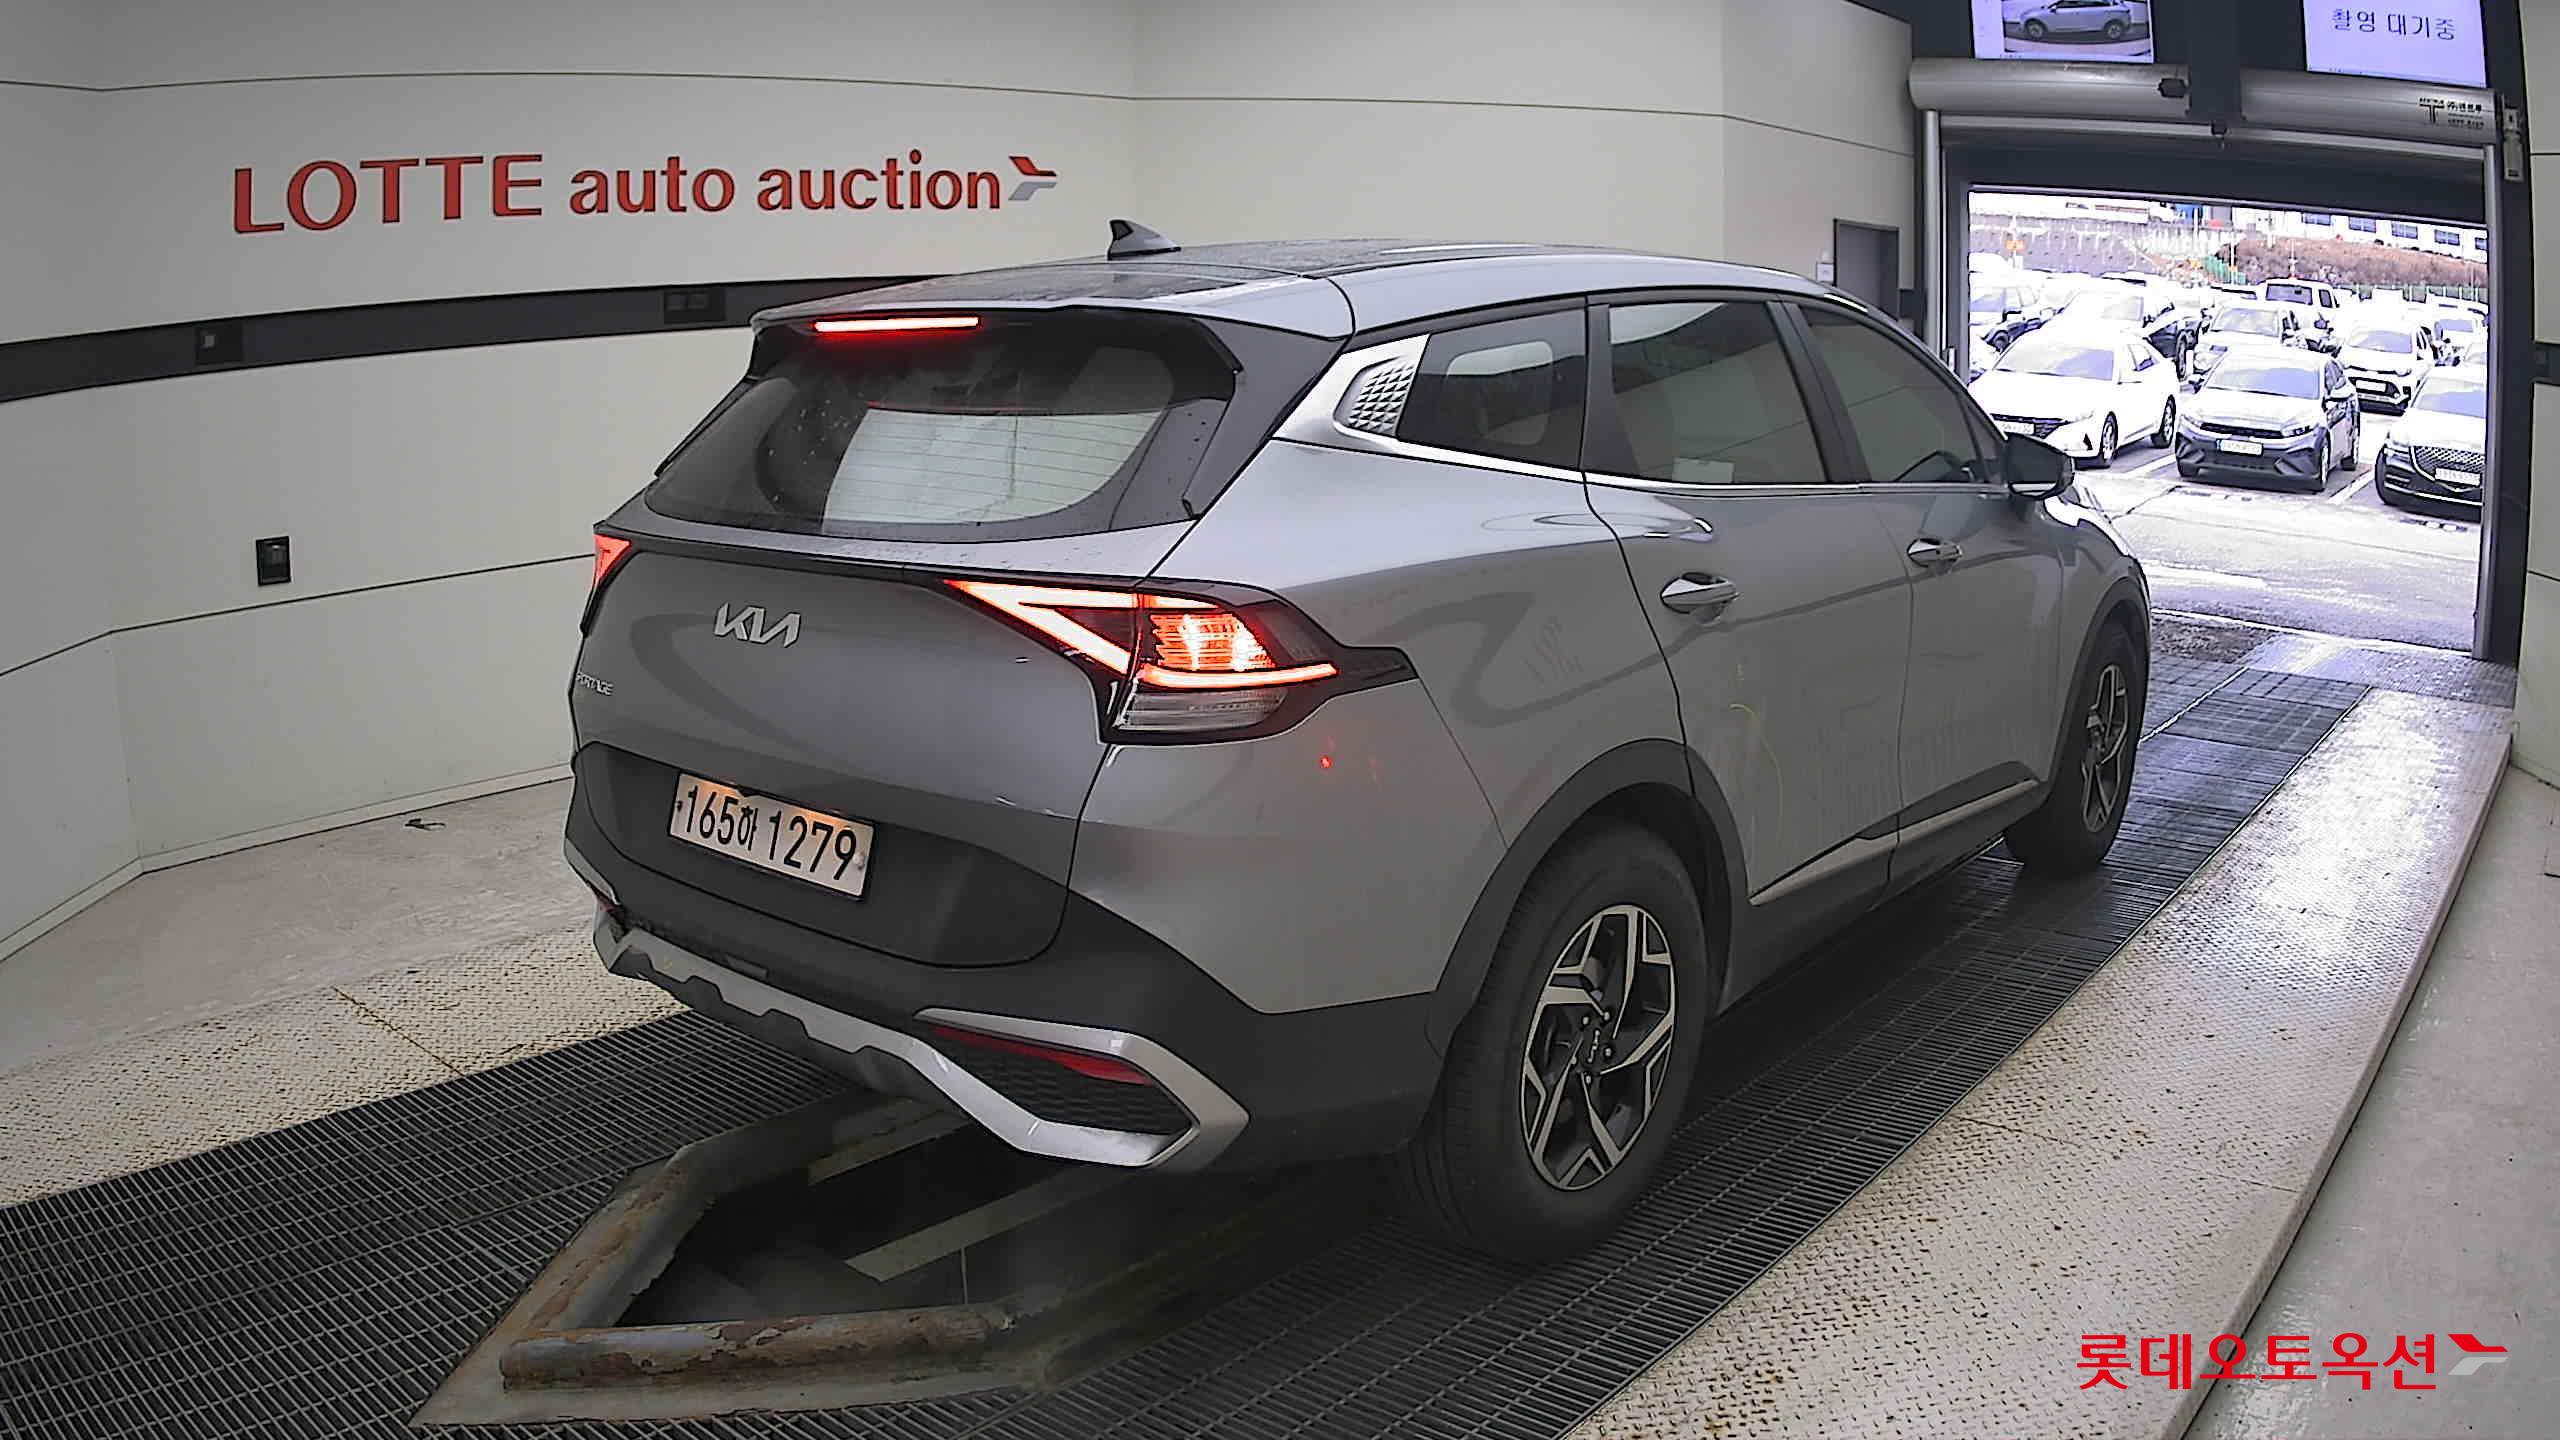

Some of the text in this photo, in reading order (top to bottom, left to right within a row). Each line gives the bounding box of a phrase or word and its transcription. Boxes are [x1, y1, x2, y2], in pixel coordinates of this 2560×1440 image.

[2332, 8, 2456, 41] 촬영 대기중
[233, 149, 1001, 234] LOTTE auto auction
[714, 602, 801, 648] KIA
[769, 811, 858, 880] 1279
